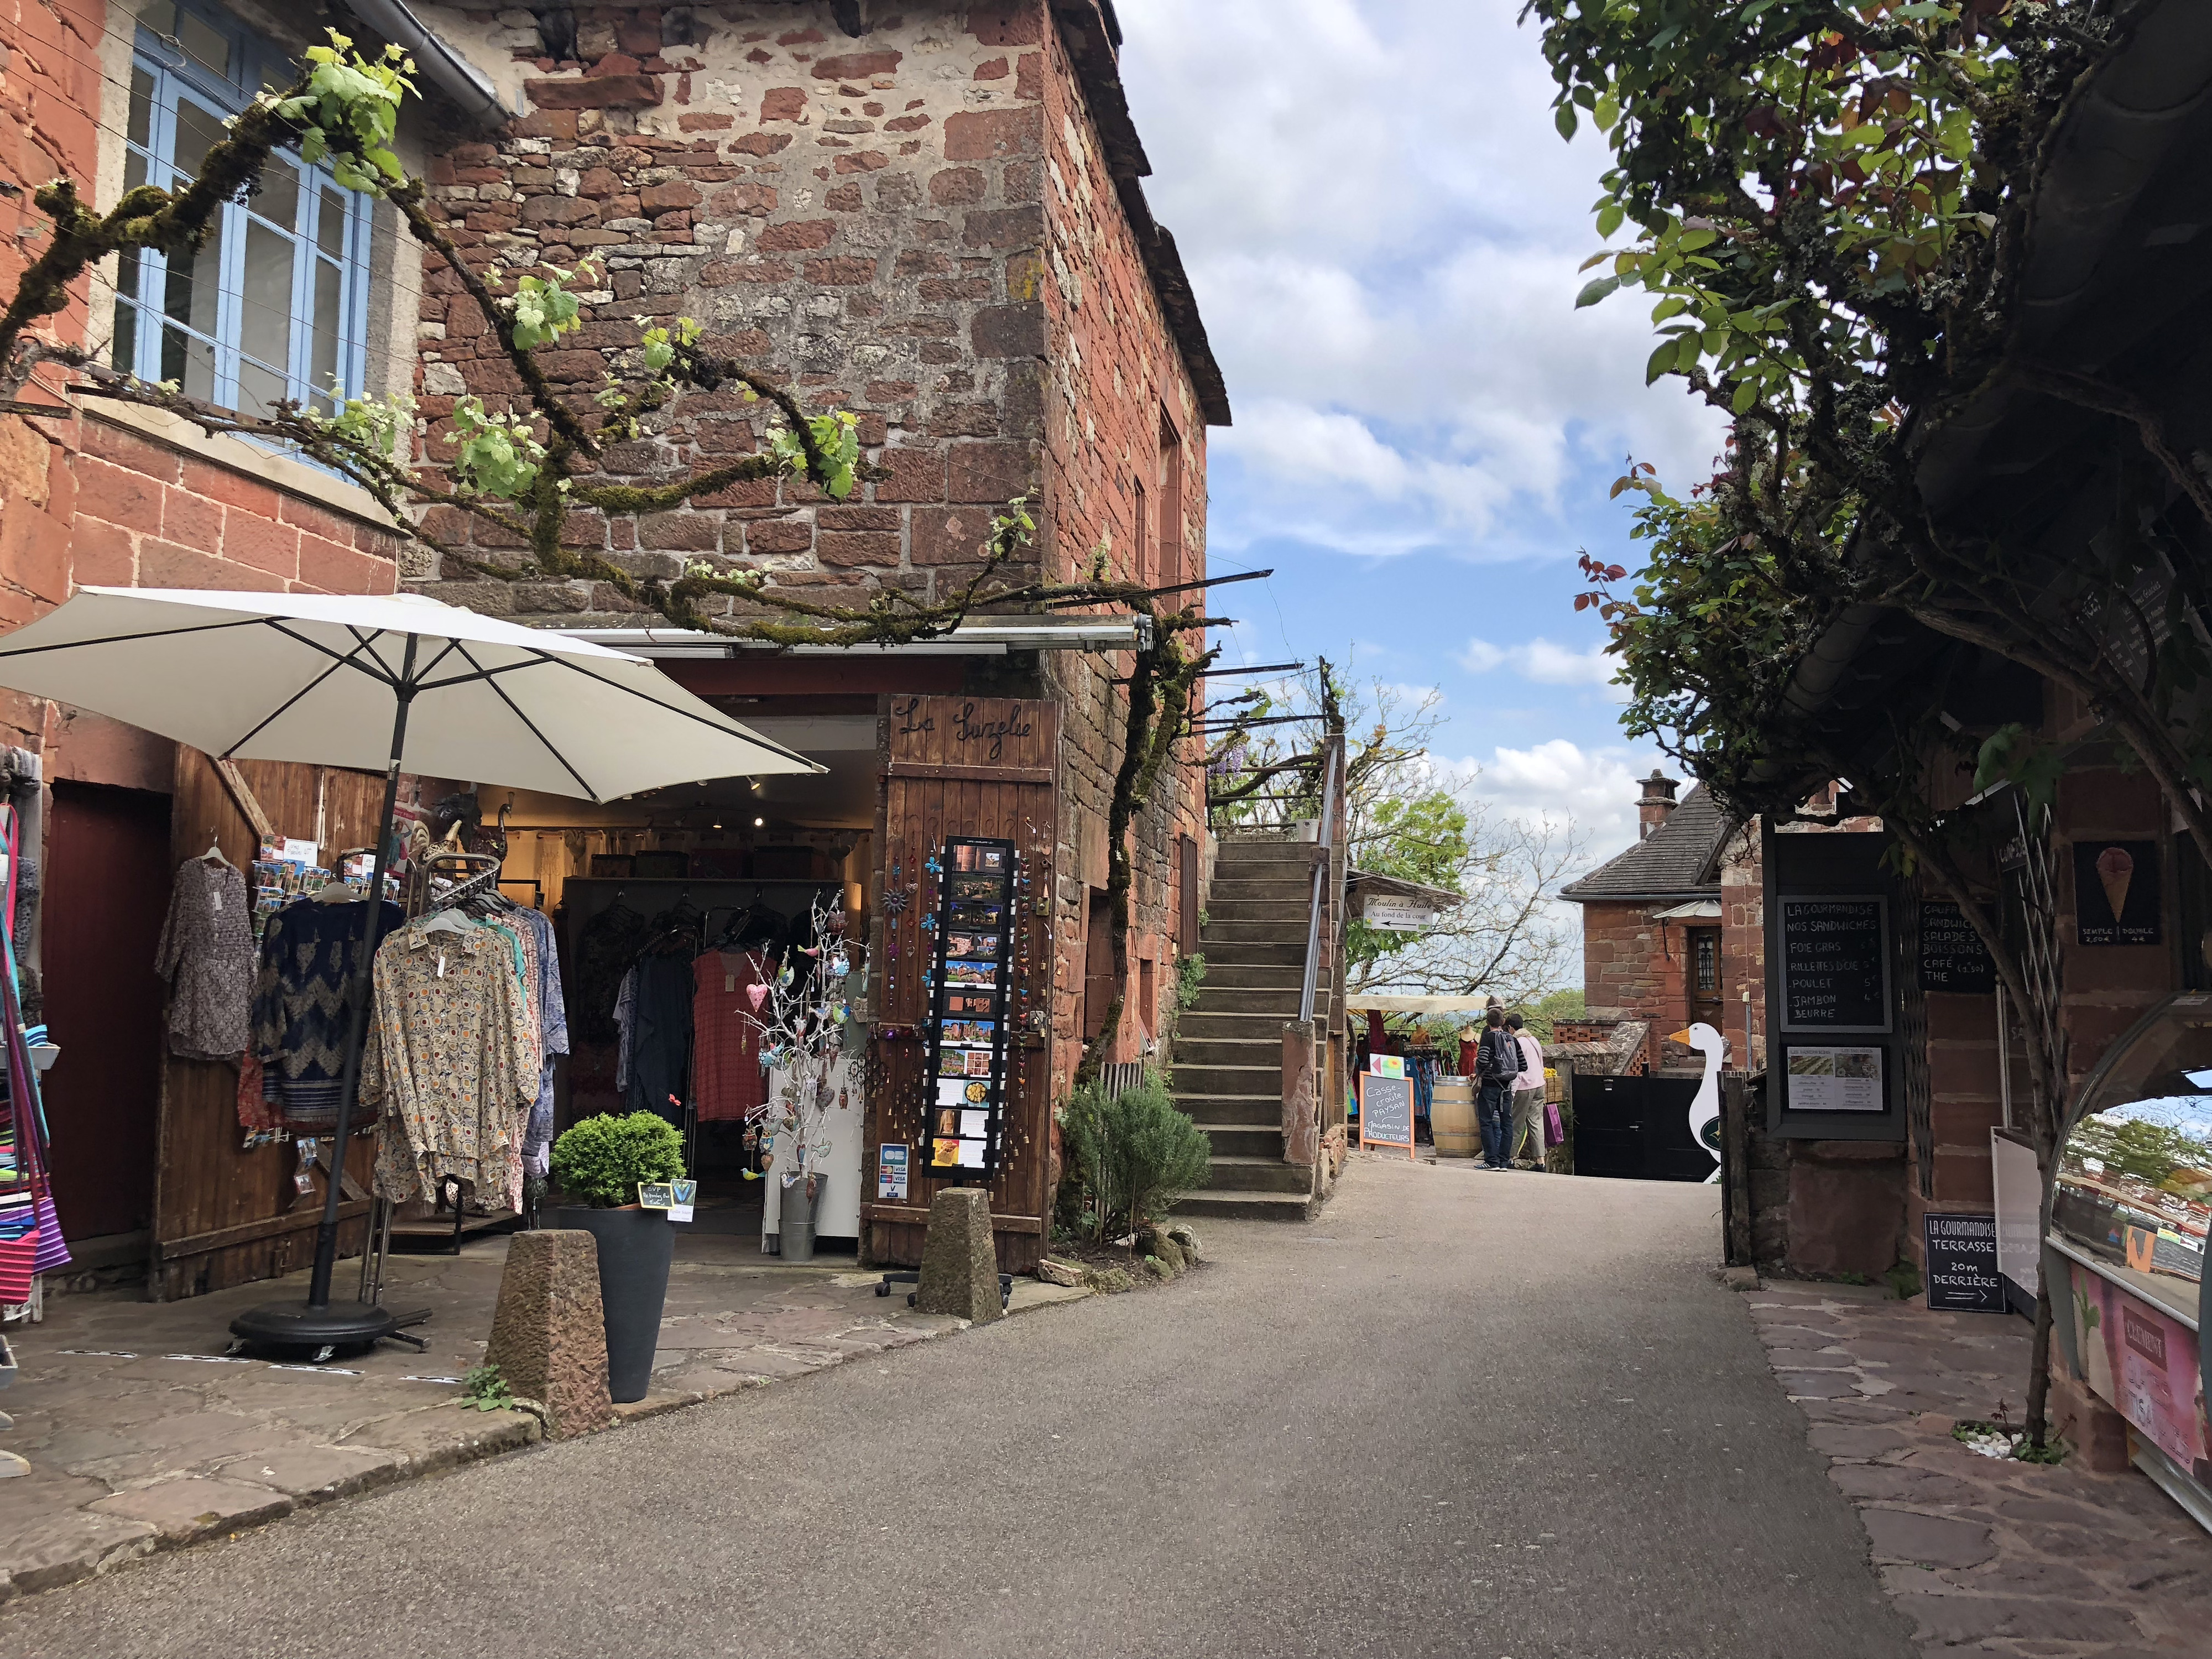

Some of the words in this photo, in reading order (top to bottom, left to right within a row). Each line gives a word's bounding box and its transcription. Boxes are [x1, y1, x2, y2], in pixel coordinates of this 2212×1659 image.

[1367, 898, 1397, 907] Moulin
[1407, 899, 1432, 909] Huile
[1787, 905, 1802, 916] LA
[1804, 904, 1874, 915] GOURMANDISE
[1787, 922, 1807, 932] NOS
[1923, 918, 1973, 928] SANDWIC
[1923, 931, 1976, 942] SALADES
[1815, 942, 1841, 953] GRAS
[1922, 944, 1983, 955] BOISSONS
[1924, 956, 1953, 968] CAFÉ
[1924, 971, 1948, 982] THE
[1792, 978, 1833, 989] POULET
[1793, 994, 1837, 1007] JAMBON
[1794, 1009, 1835, 1019] BEURRE
[1376, 1092, 1404, 1107] croûte
[1372, 1100, 1405, 1118] PAYSAN
[1368, 1120, 1400, 1131] MAGASIN
[1364, 1127, 1410, 1142] PRODUCTEURS
[1929, 1220, 1939, 1235] LA
[1940, 1220, 1997, 1238] GOURMANDISE
[1932, 1240, 1994, 1253] TERRASSE
[1933, 1274, 1998, 1287] DERRIÈRE
